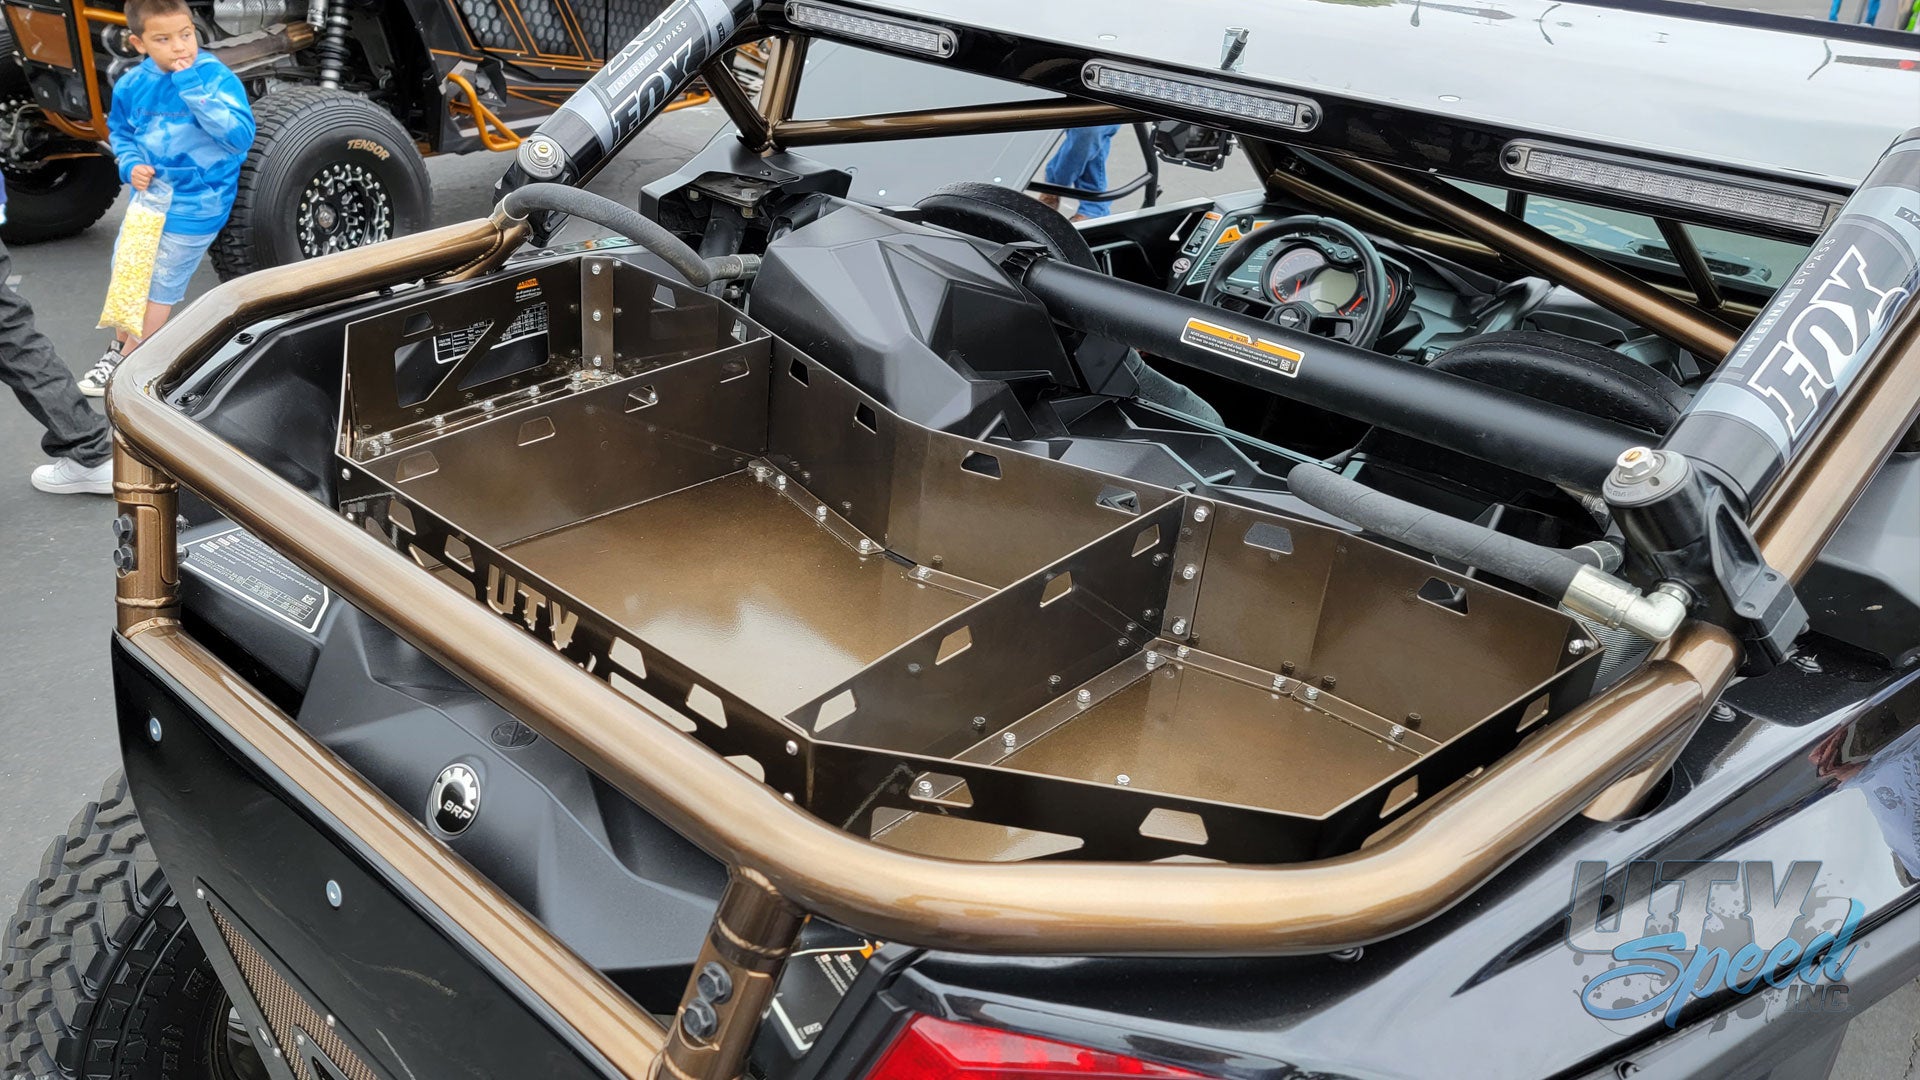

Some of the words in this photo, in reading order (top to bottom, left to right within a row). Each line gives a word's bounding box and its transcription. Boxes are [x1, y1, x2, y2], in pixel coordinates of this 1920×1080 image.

[612, 51, 659, 94] INTERNAL
[656, 20, 688, 52] BYPASS
[346, 138, 391, 161] TENSOR
[1737, 291, 1796, 358] INTERNAL
[1793, 237, 1837, 287] BYPASS
[1747, 244, 1910, 442] FOX
[486, 563, 580, 651] UTV
[443, 800, 472, 819] BRP
